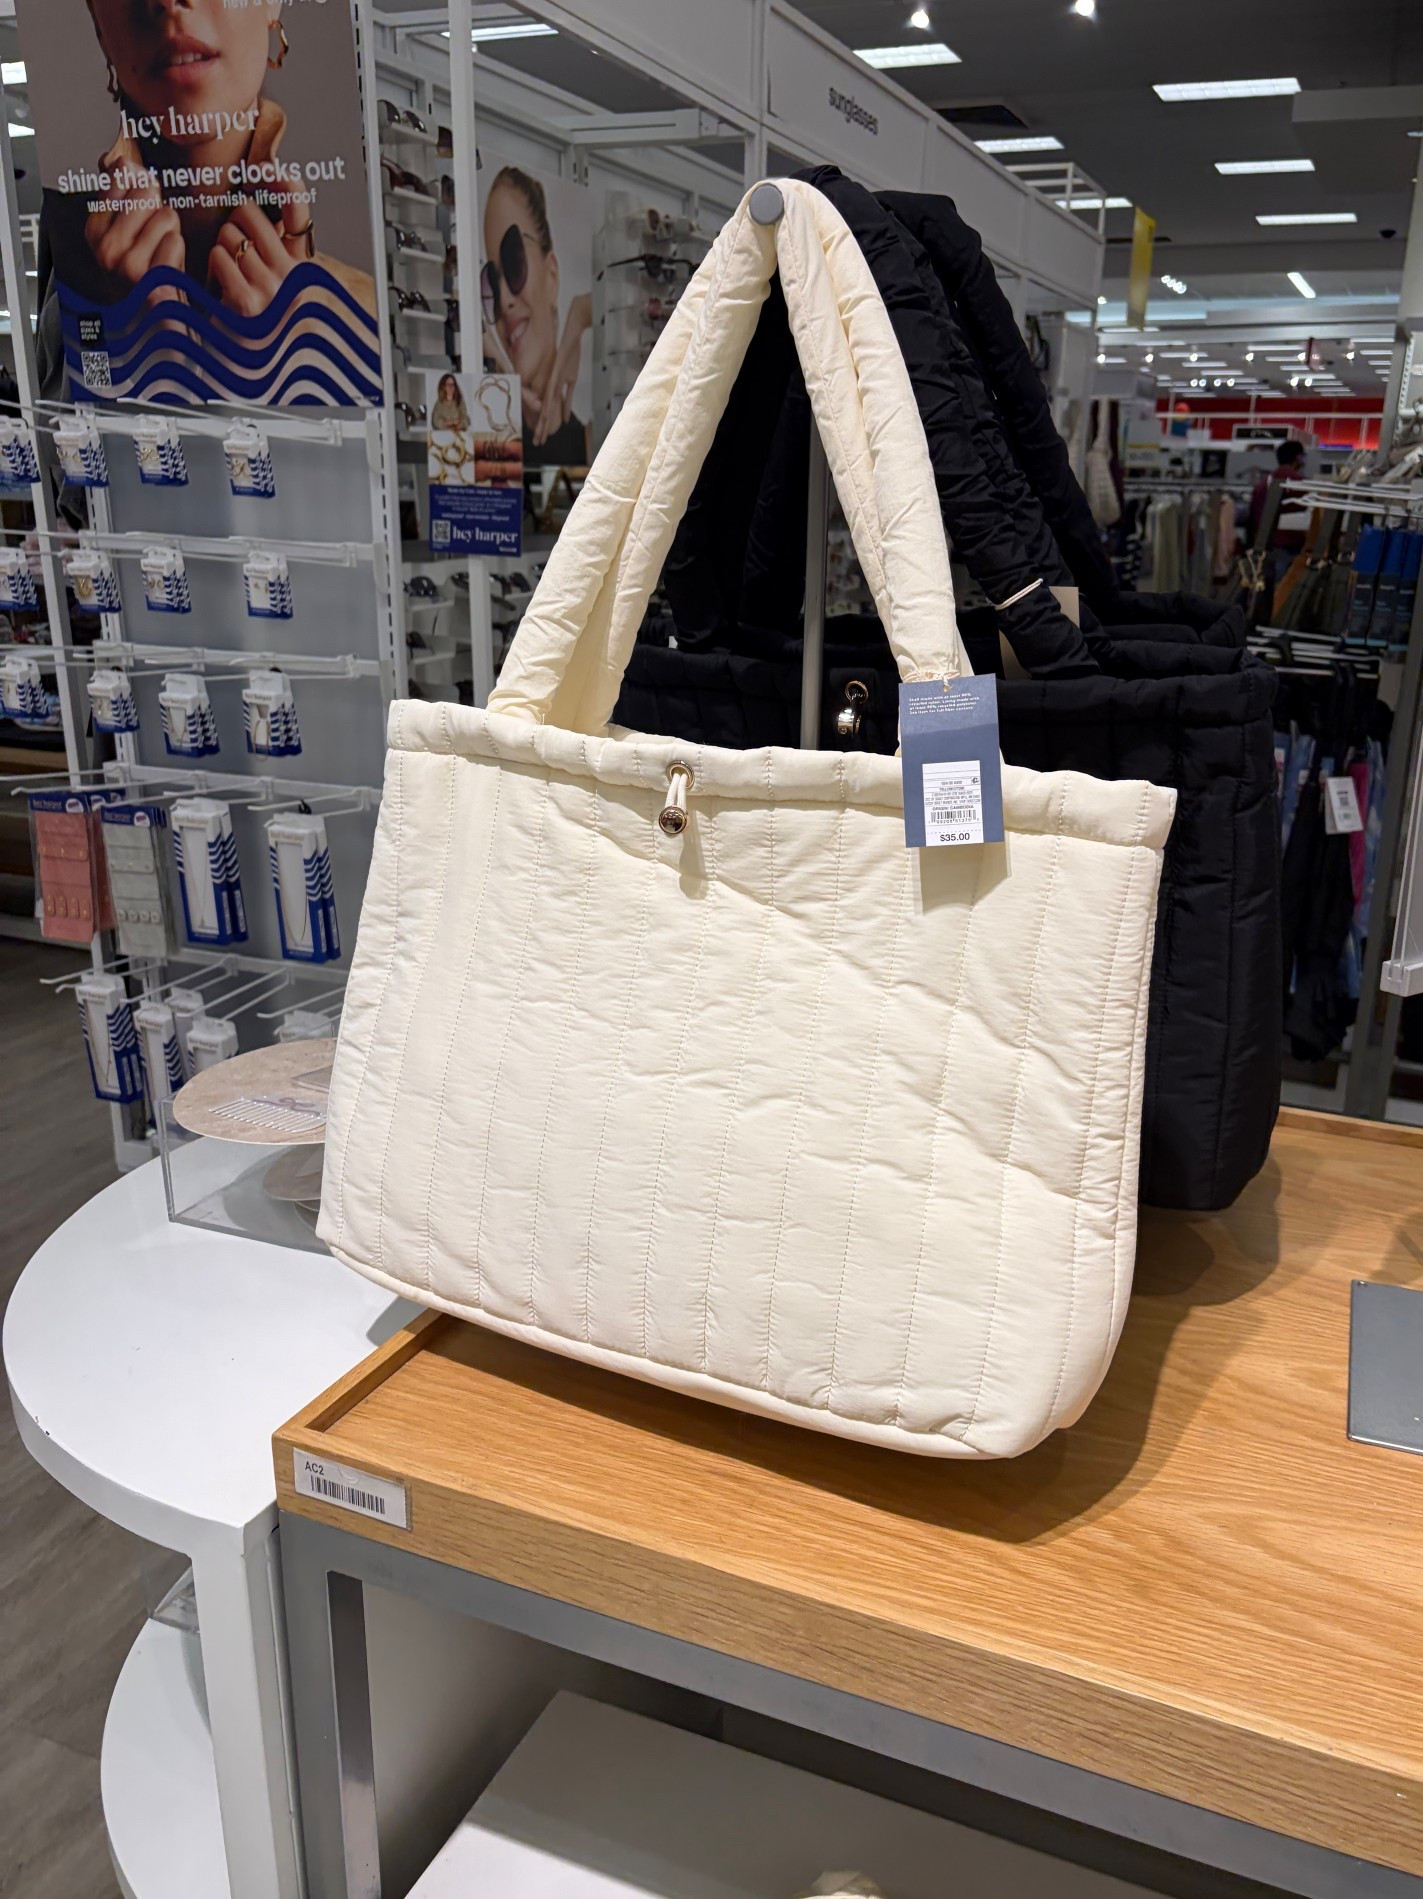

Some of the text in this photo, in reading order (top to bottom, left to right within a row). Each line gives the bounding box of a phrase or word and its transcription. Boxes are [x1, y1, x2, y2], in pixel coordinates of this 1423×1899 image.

[120, 105, 260, 144] hey harper
[829, 88, 878, 136] sunglasses
[58, 155, 346, 194] shine that never clocks out
[87, 187, 317, 215] waterproof non-tarnish lifeproof
[452, 525, 519, 545] hey harper
[940, 833, 970, 842] $35.00
[305, 1461, 325, 1476] AC2
